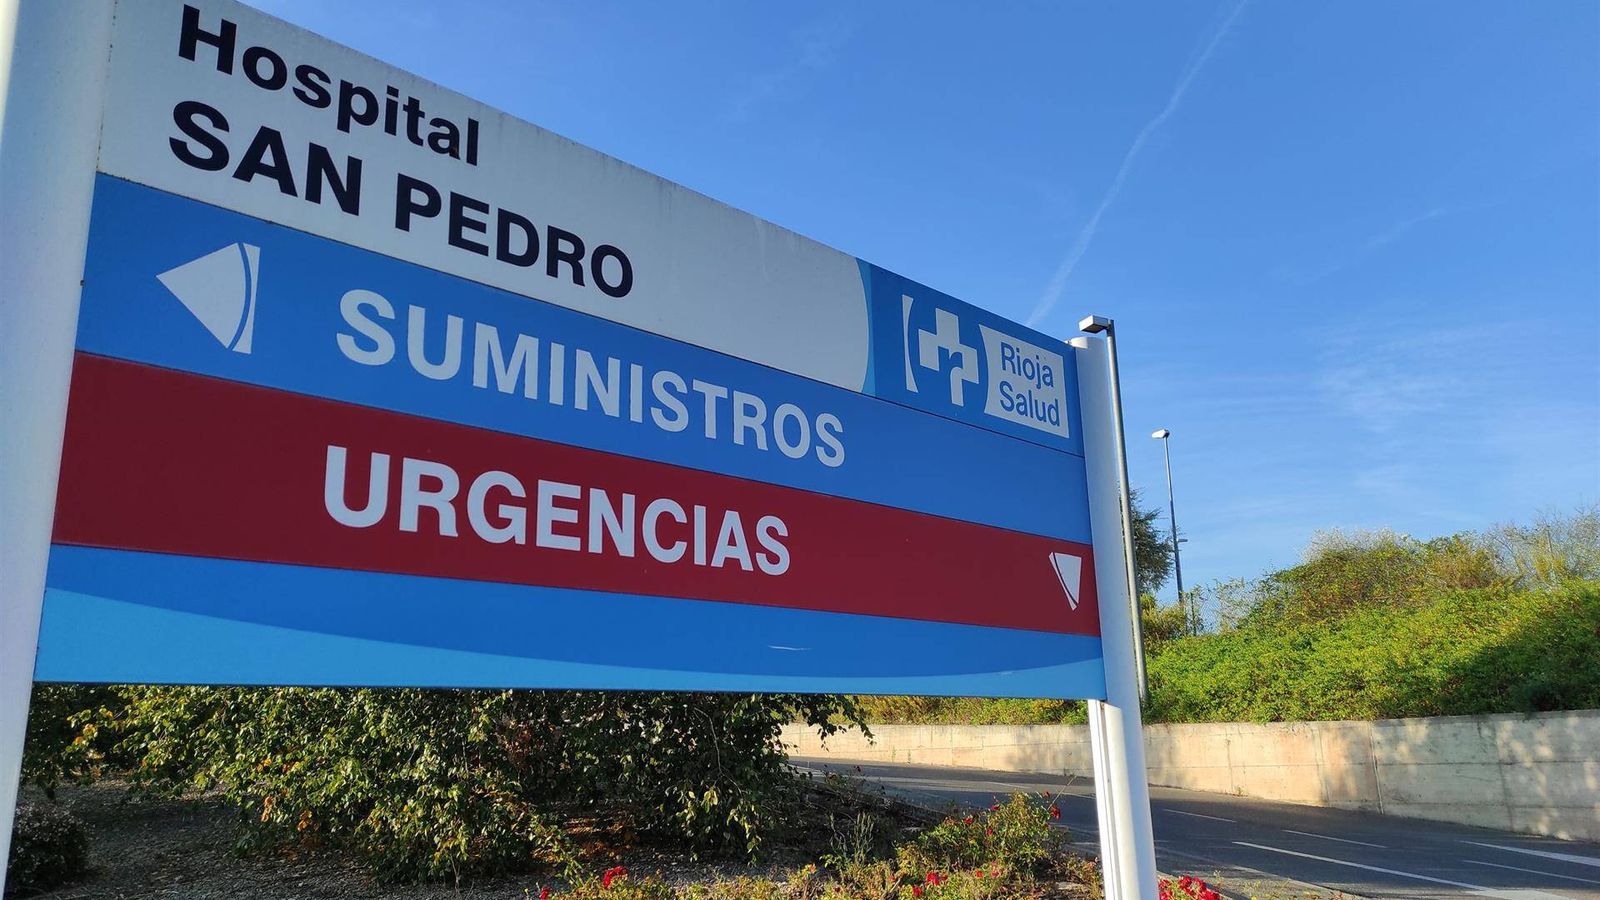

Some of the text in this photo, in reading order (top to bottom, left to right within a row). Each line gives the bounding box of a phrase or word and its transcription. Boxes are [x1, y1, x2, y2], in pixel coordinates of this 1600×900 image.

[178, 4, 480, 166] Hospital
[169, 100, 634, 299] SAN PEDRO
[336, 289, 846, 468] SUMINISTROS
[1000, 381, 1060, 426] Salud
[1001, 342, 1054, 389] Rioja
[324, 445, 790, 575] URGENCIAS
